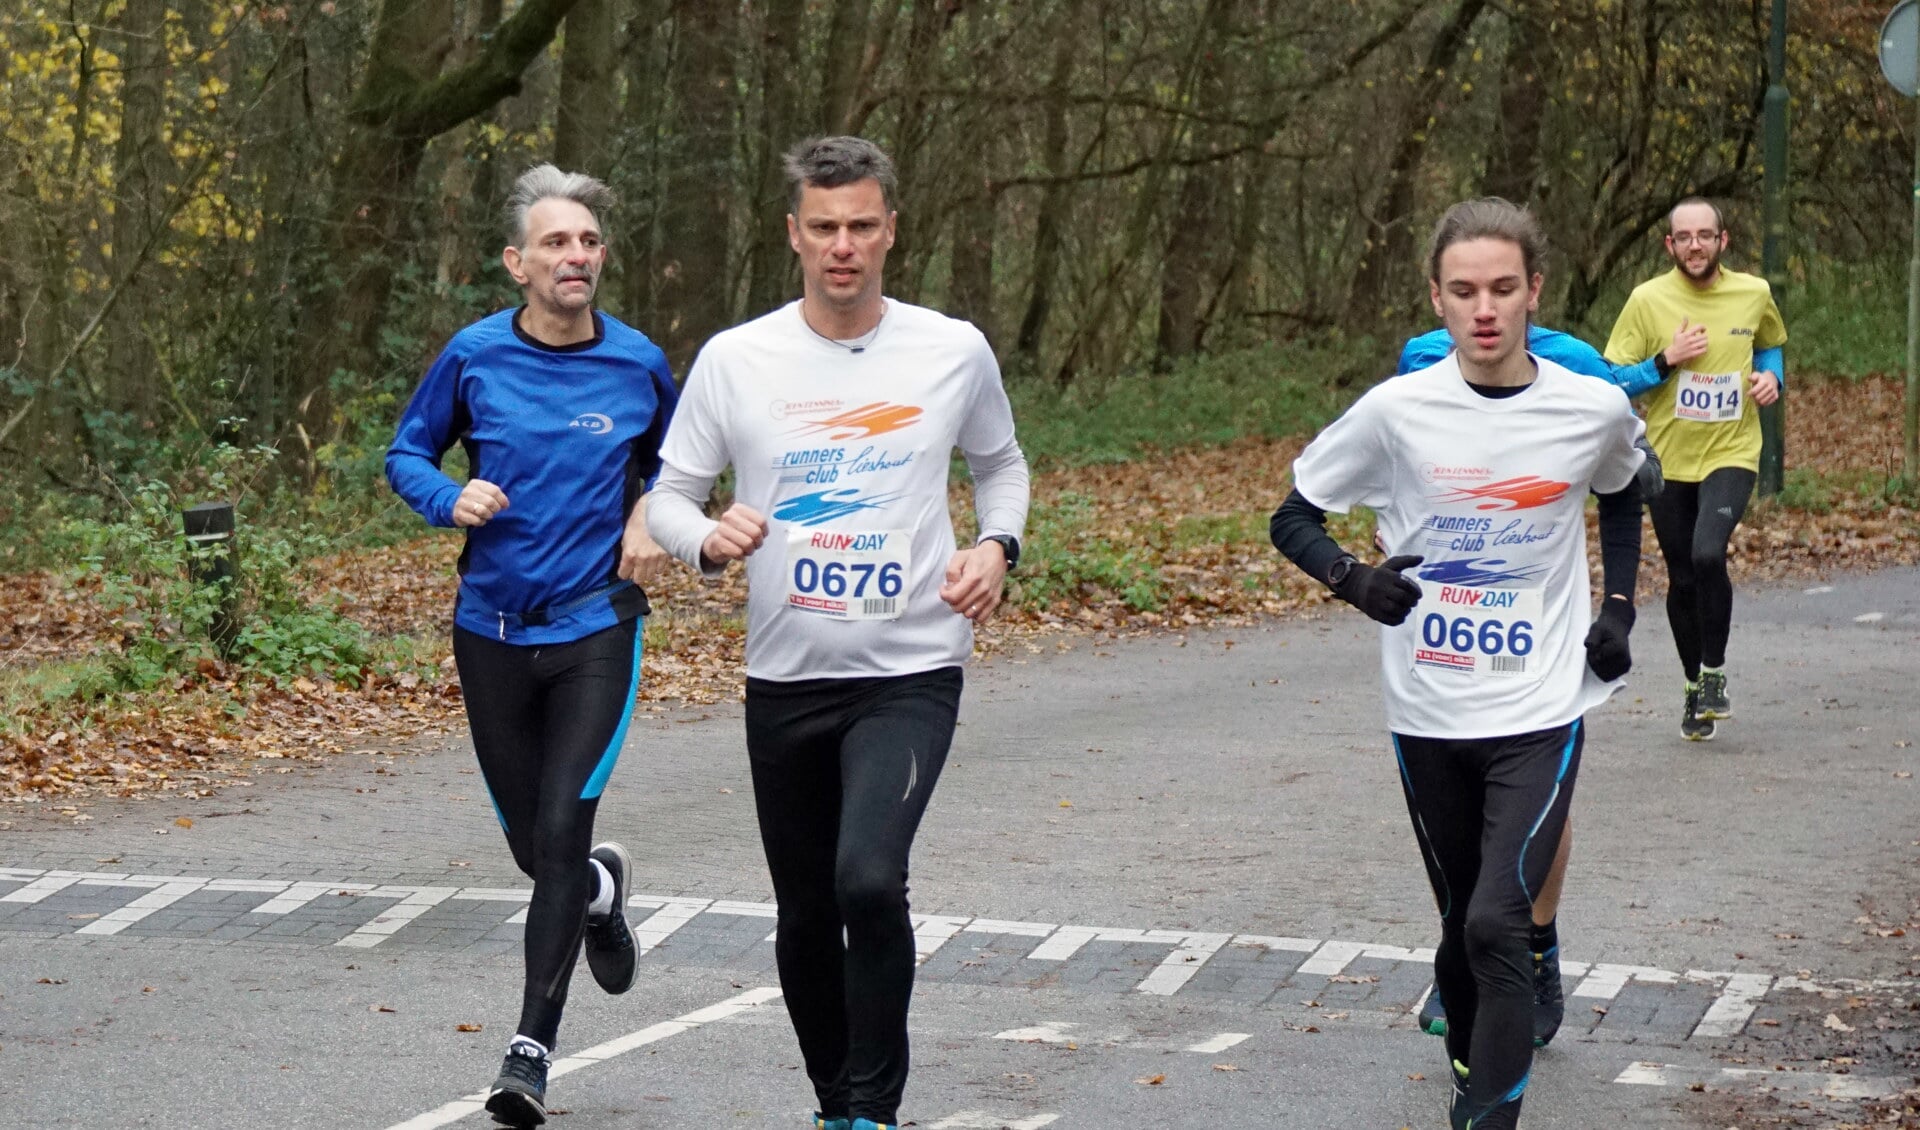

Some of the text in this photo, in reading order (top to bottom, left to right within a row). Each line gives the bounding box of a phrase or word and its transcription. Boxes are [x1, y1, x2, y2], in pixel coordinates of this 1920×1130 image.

[1680, 388, 1739, 409] 0014
[783, 448, 845, 465] runners
[806, 464, 839, 484] club
[1431, 515, 1493, 532] runners
[1451, 534, 1485, 551] club
[794, 557, 903, 598] 0676
[1423, 612, 1533, 656] 0666
